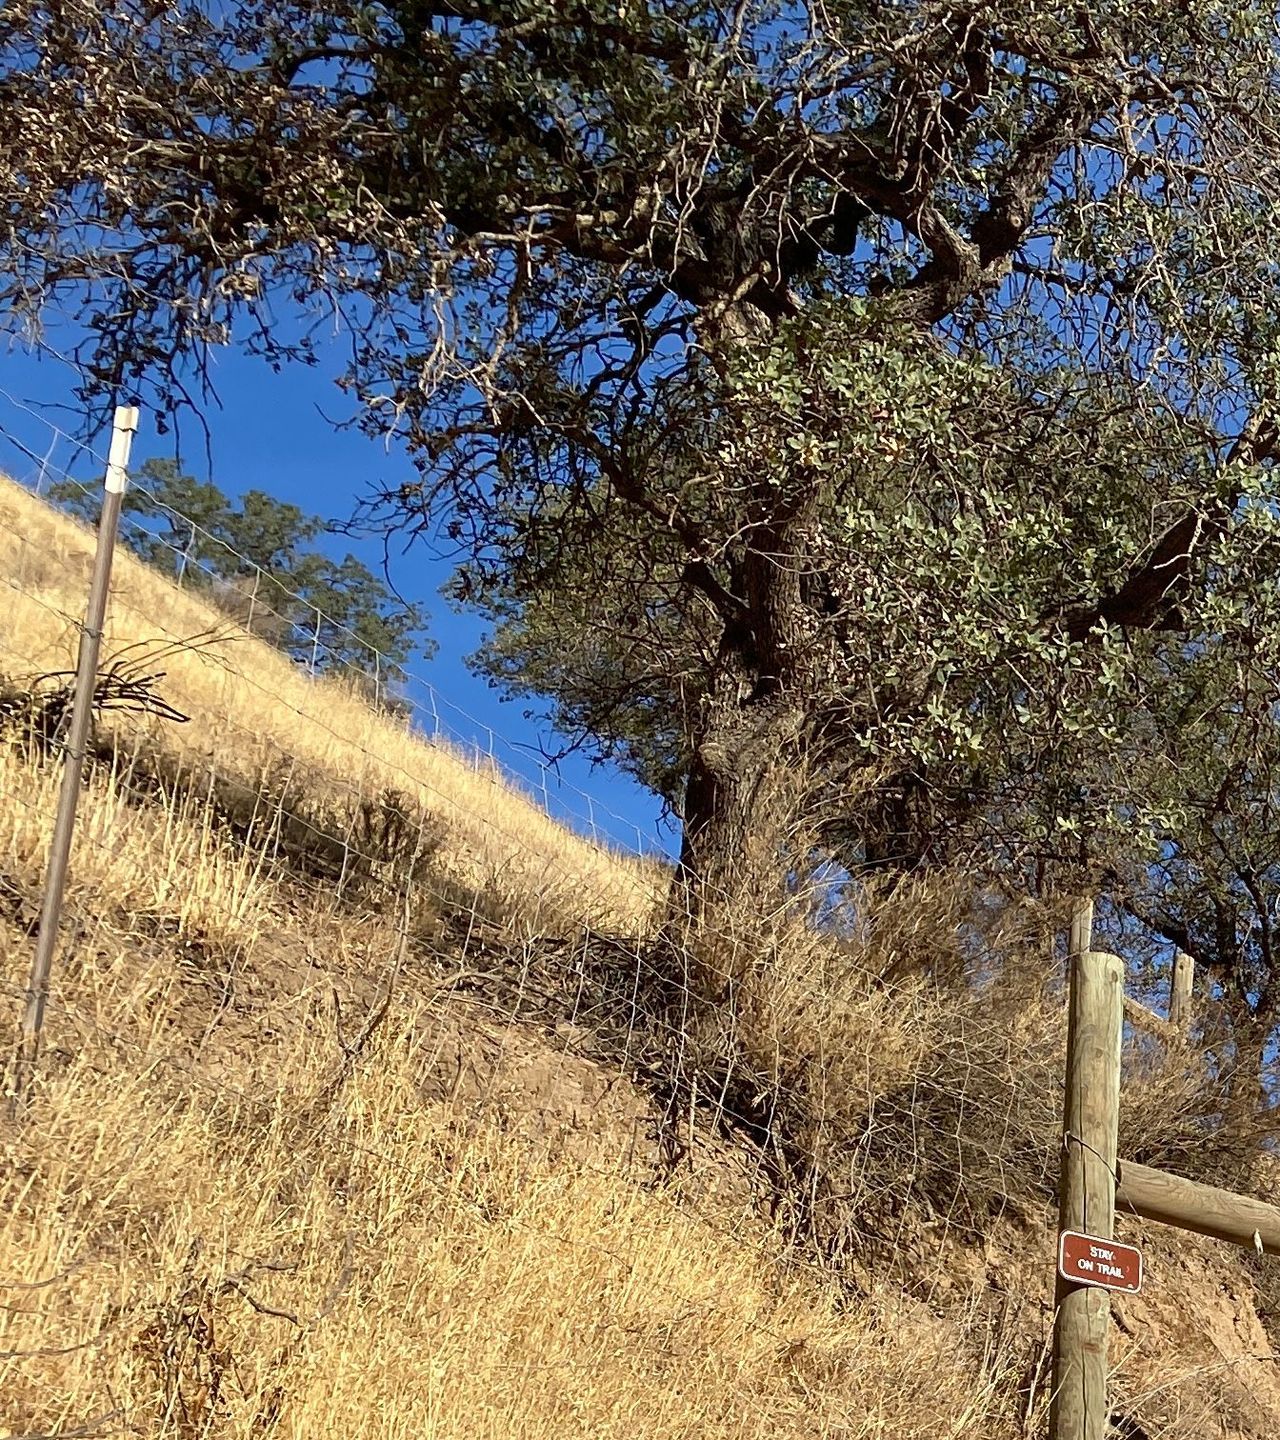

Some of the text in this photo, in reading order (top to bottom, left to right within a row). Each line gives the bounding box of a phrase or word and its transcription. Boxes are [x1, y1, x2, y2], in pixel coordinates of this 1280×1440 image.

[1090, 1247, 1113, 1261] STAY
[1078, 1259, 1124, 1279] ON TRAIL
